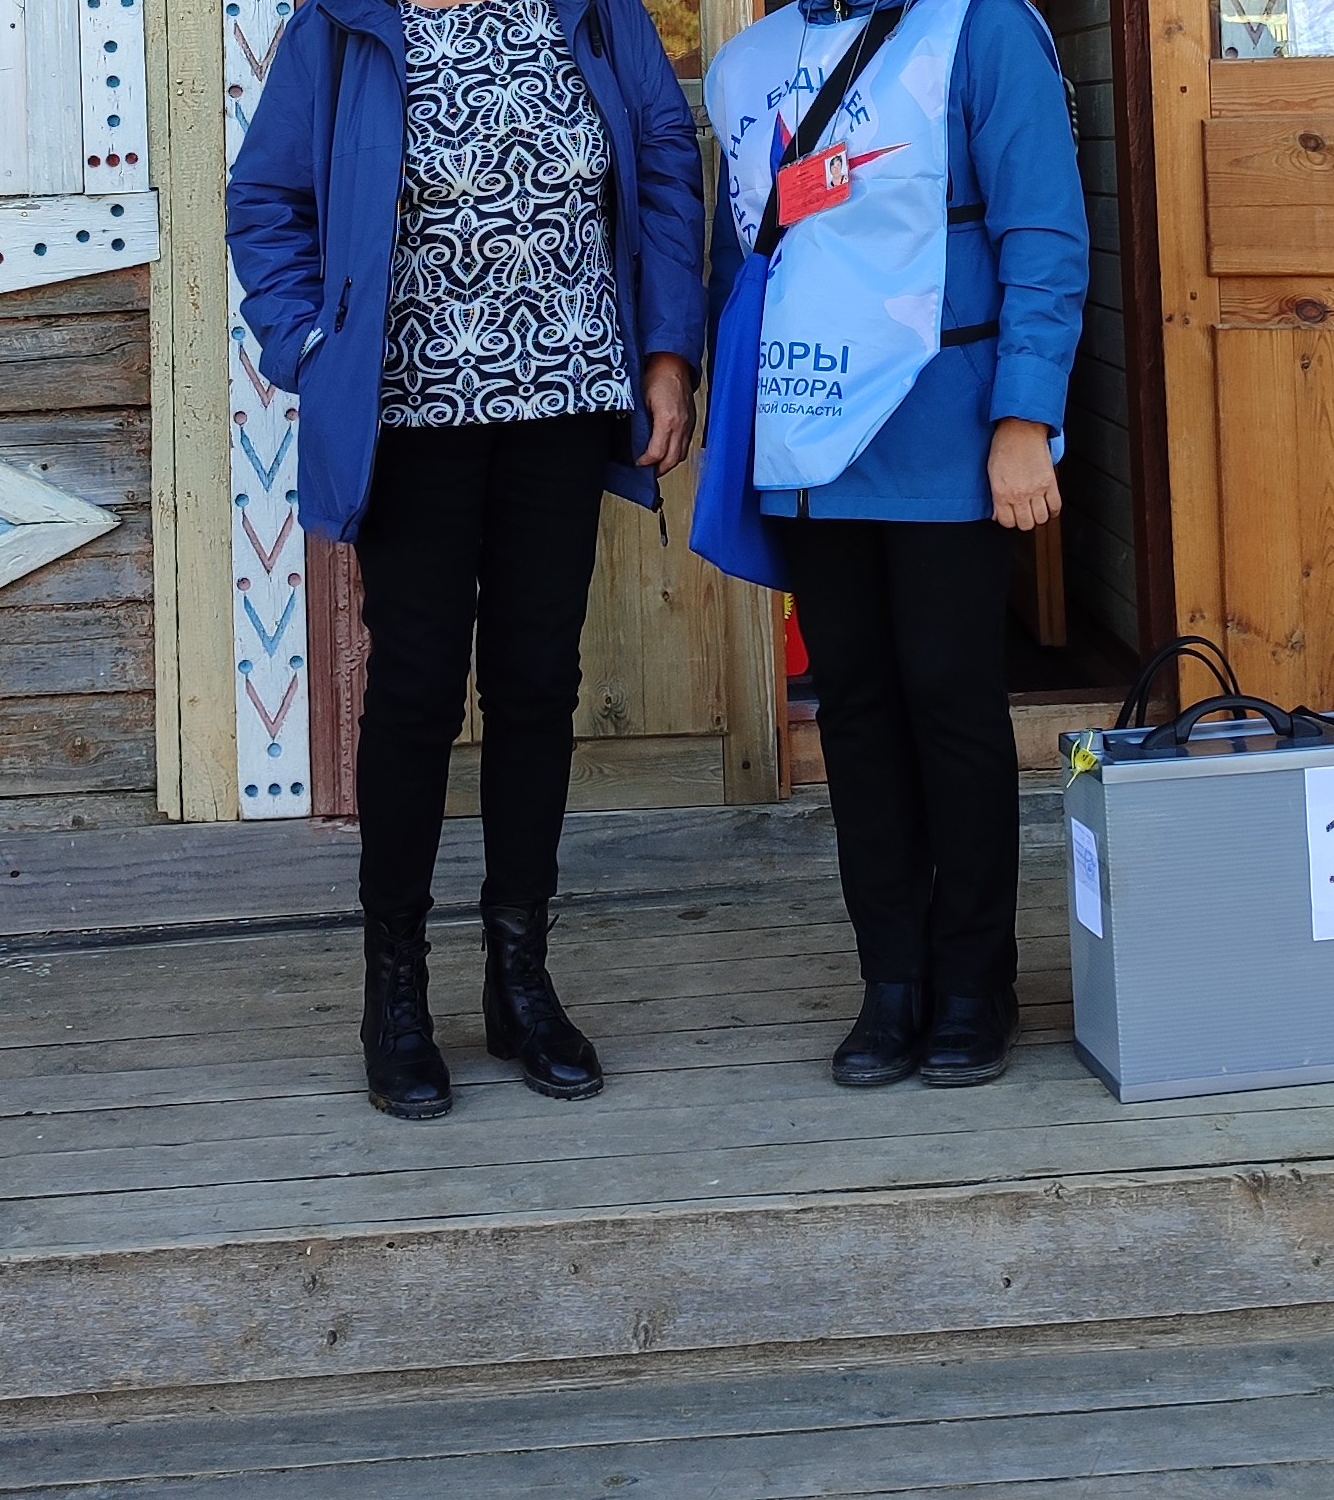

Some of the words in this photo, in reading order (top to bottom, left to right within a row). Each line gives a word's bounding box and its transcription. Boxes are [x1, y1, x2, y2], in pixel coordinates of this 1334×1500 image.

[759, 341, 850, 374] БОРЫ
[757, 376, 843, 400] НАТОРА
[781, 403, 843, 417] ОБЛАСТИ
